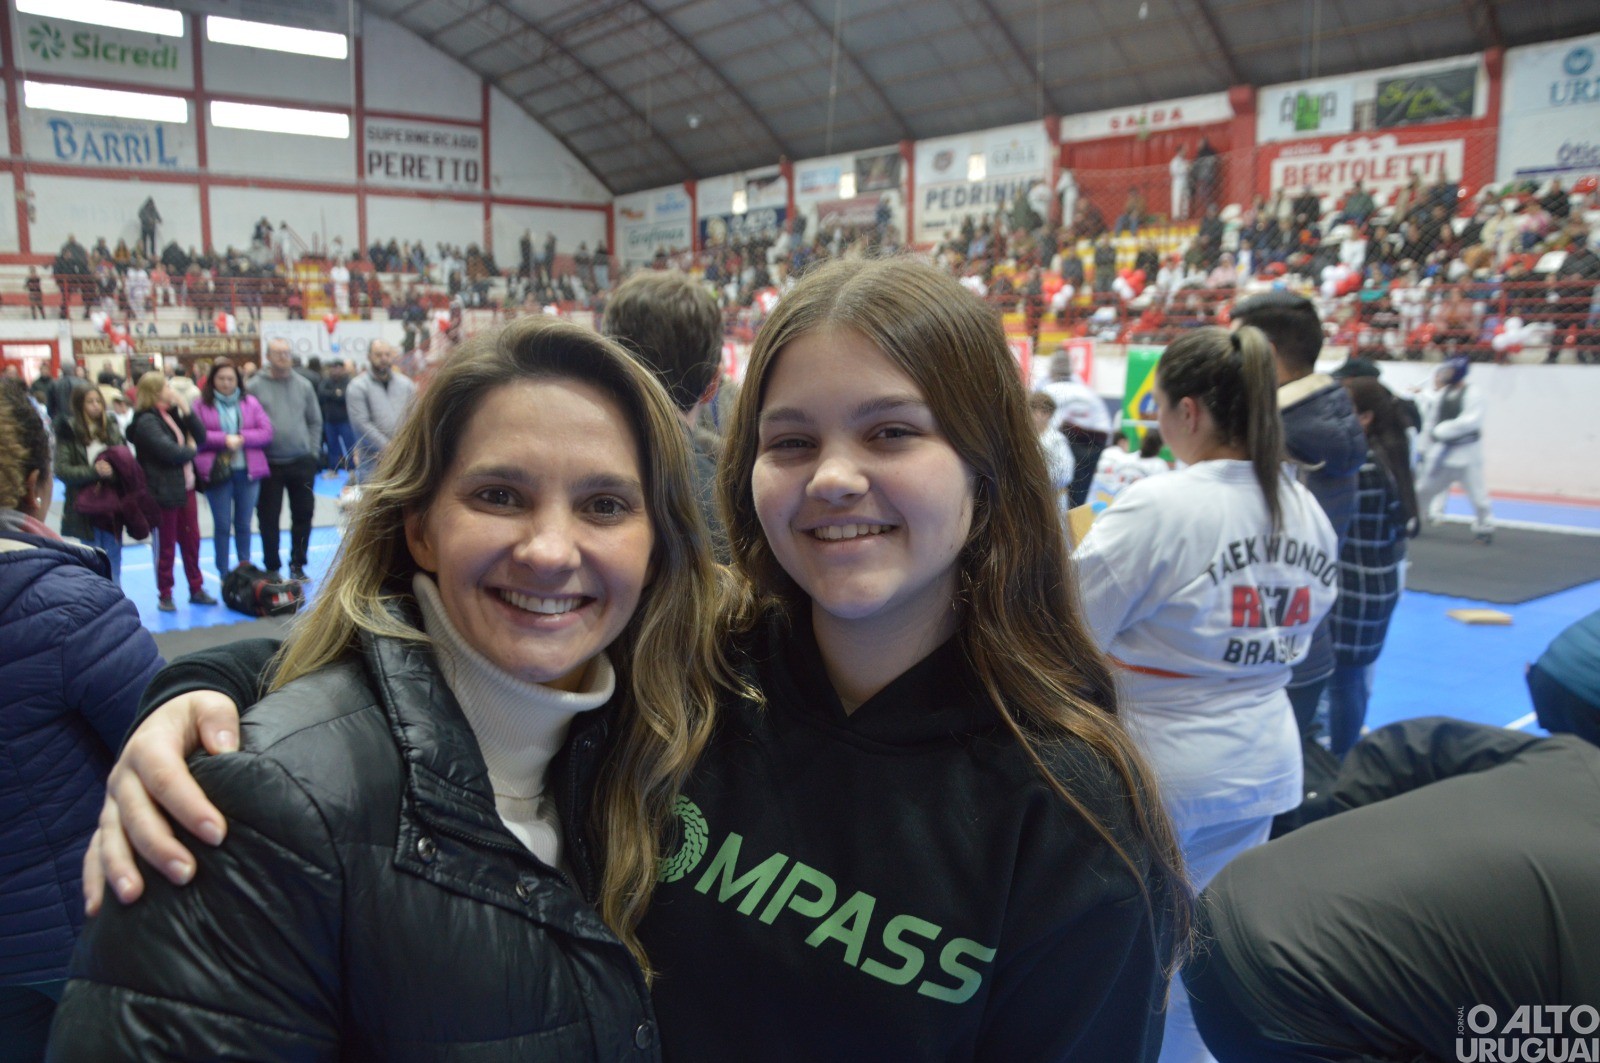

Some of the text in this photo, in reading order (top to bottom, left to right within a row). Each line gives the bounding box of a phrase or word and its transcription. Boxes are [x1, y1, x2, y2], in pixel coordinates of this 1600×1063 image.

[72, 32, 178, 69] Sicredi
[47, 117, 178, 167] BARRIL
[367, 150, 479, 183] PERETTO
[1283, 151, 1447, 188] BERTOLETTI
[1223, 634, 1300, 666] BRASIL
[657, 794, 997, 1004] OMPASS
